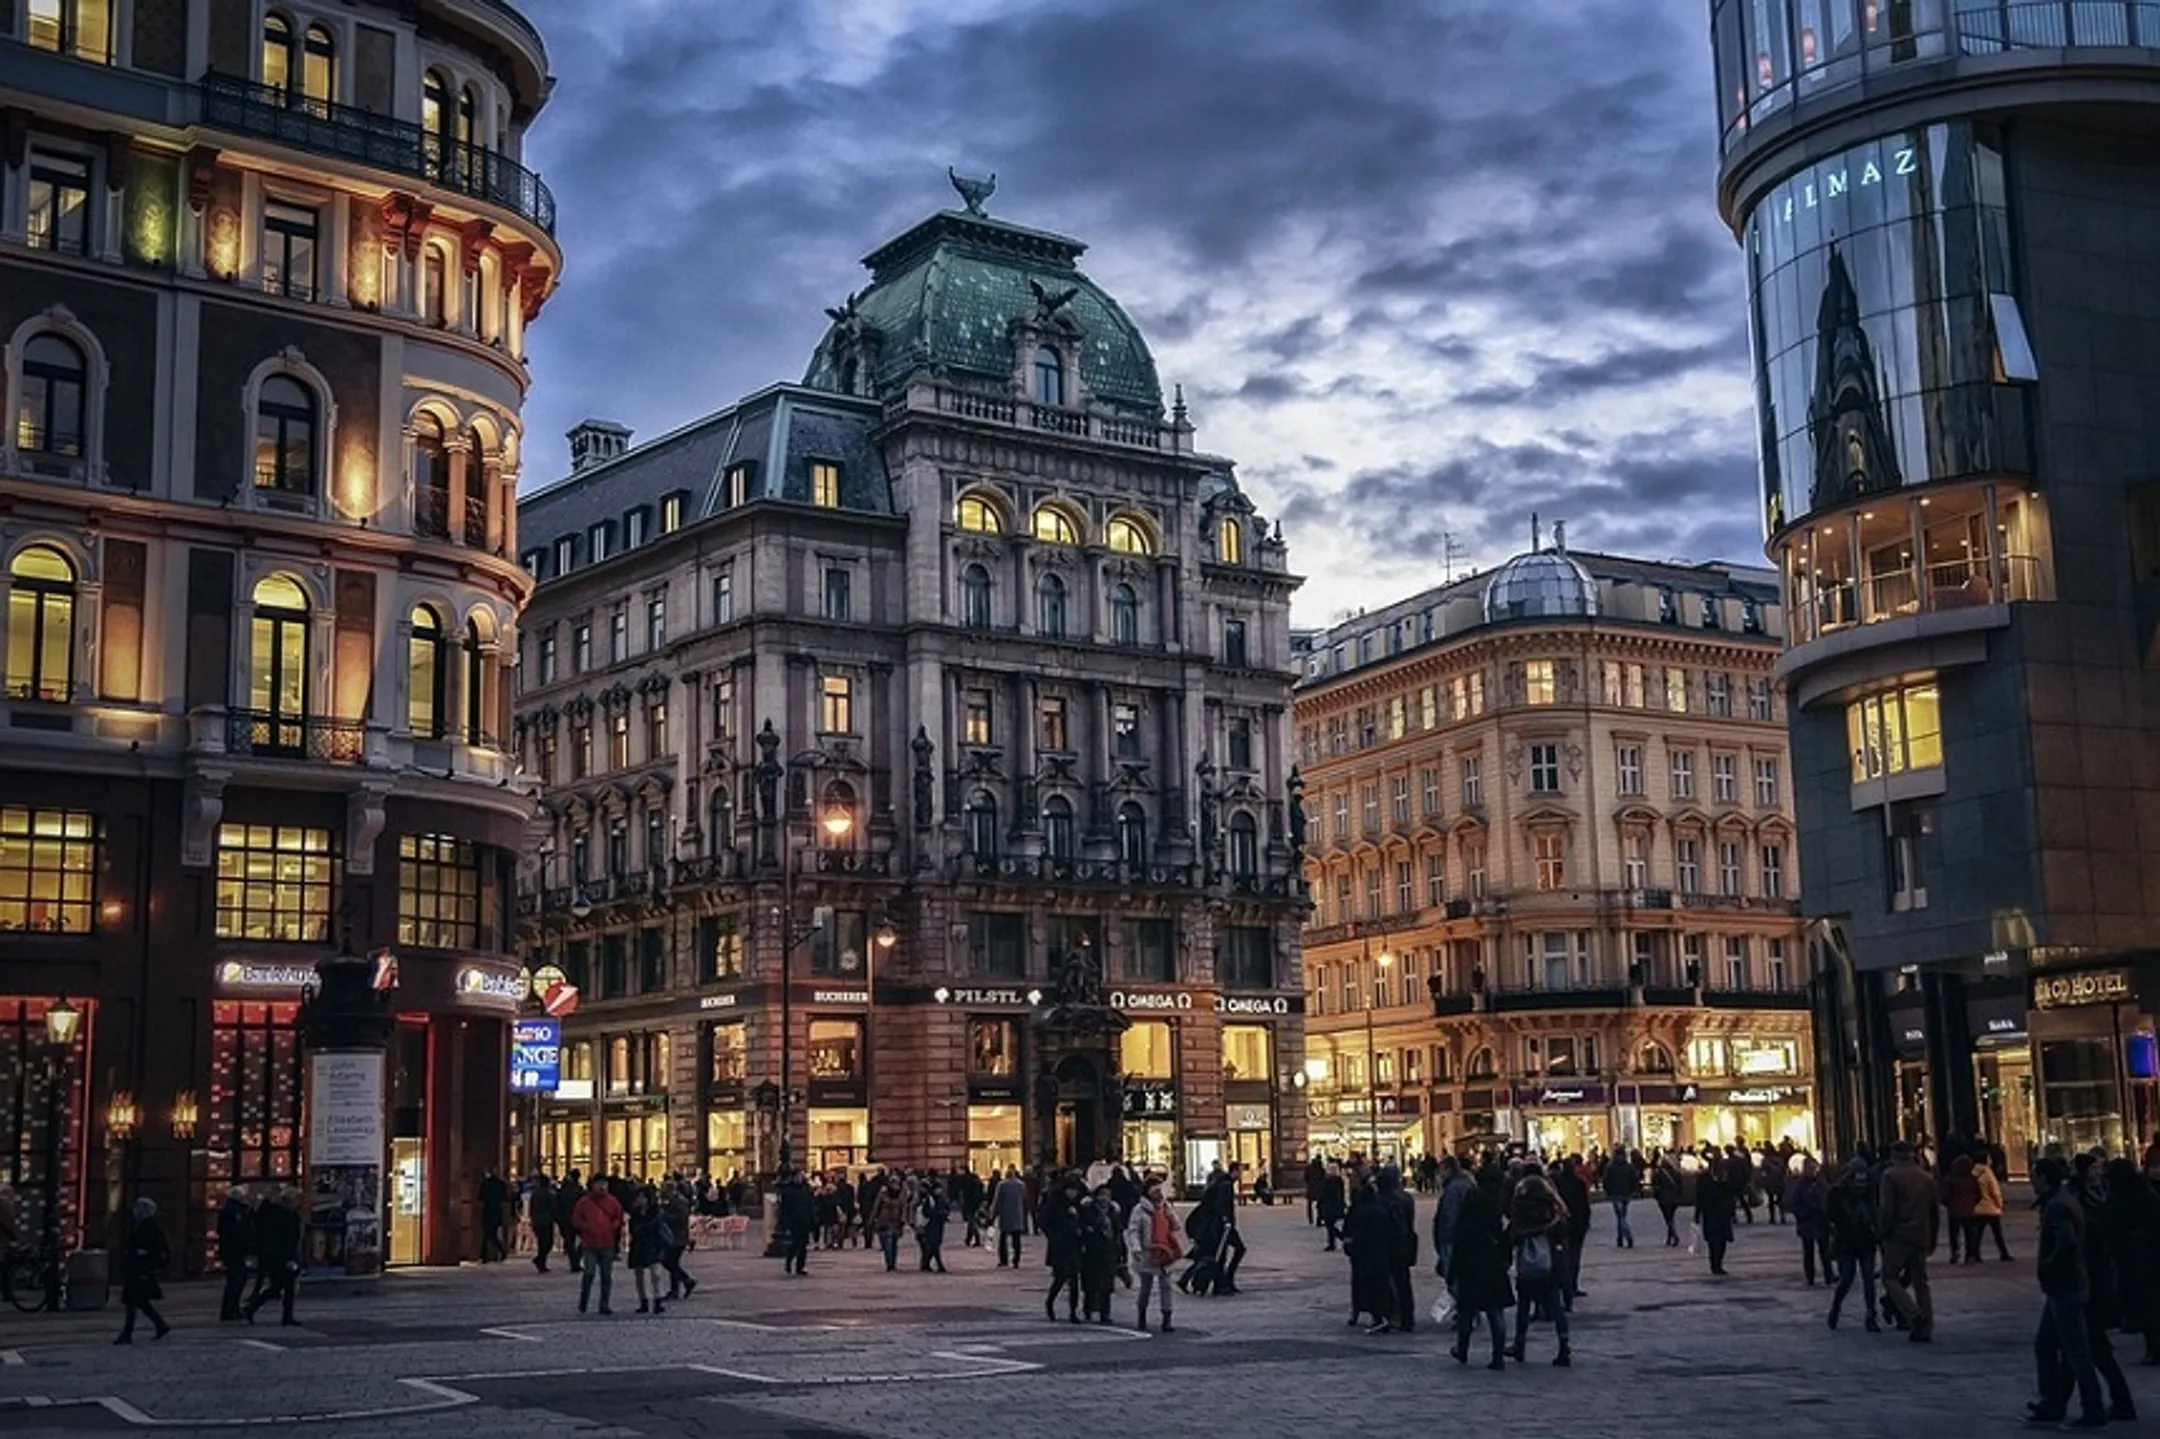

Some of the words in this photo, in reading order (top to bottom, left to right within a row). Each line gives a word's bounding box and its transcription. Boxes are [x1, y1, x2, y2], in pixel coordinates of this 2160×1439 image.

[2072, 972, 2127, 996] HOTEL
[954, 989, 1023, 1004] PILSTL
[1127, 995, 1174, 1009] OMEGA
[1228, 998, 1272, 1013] OMEGA
